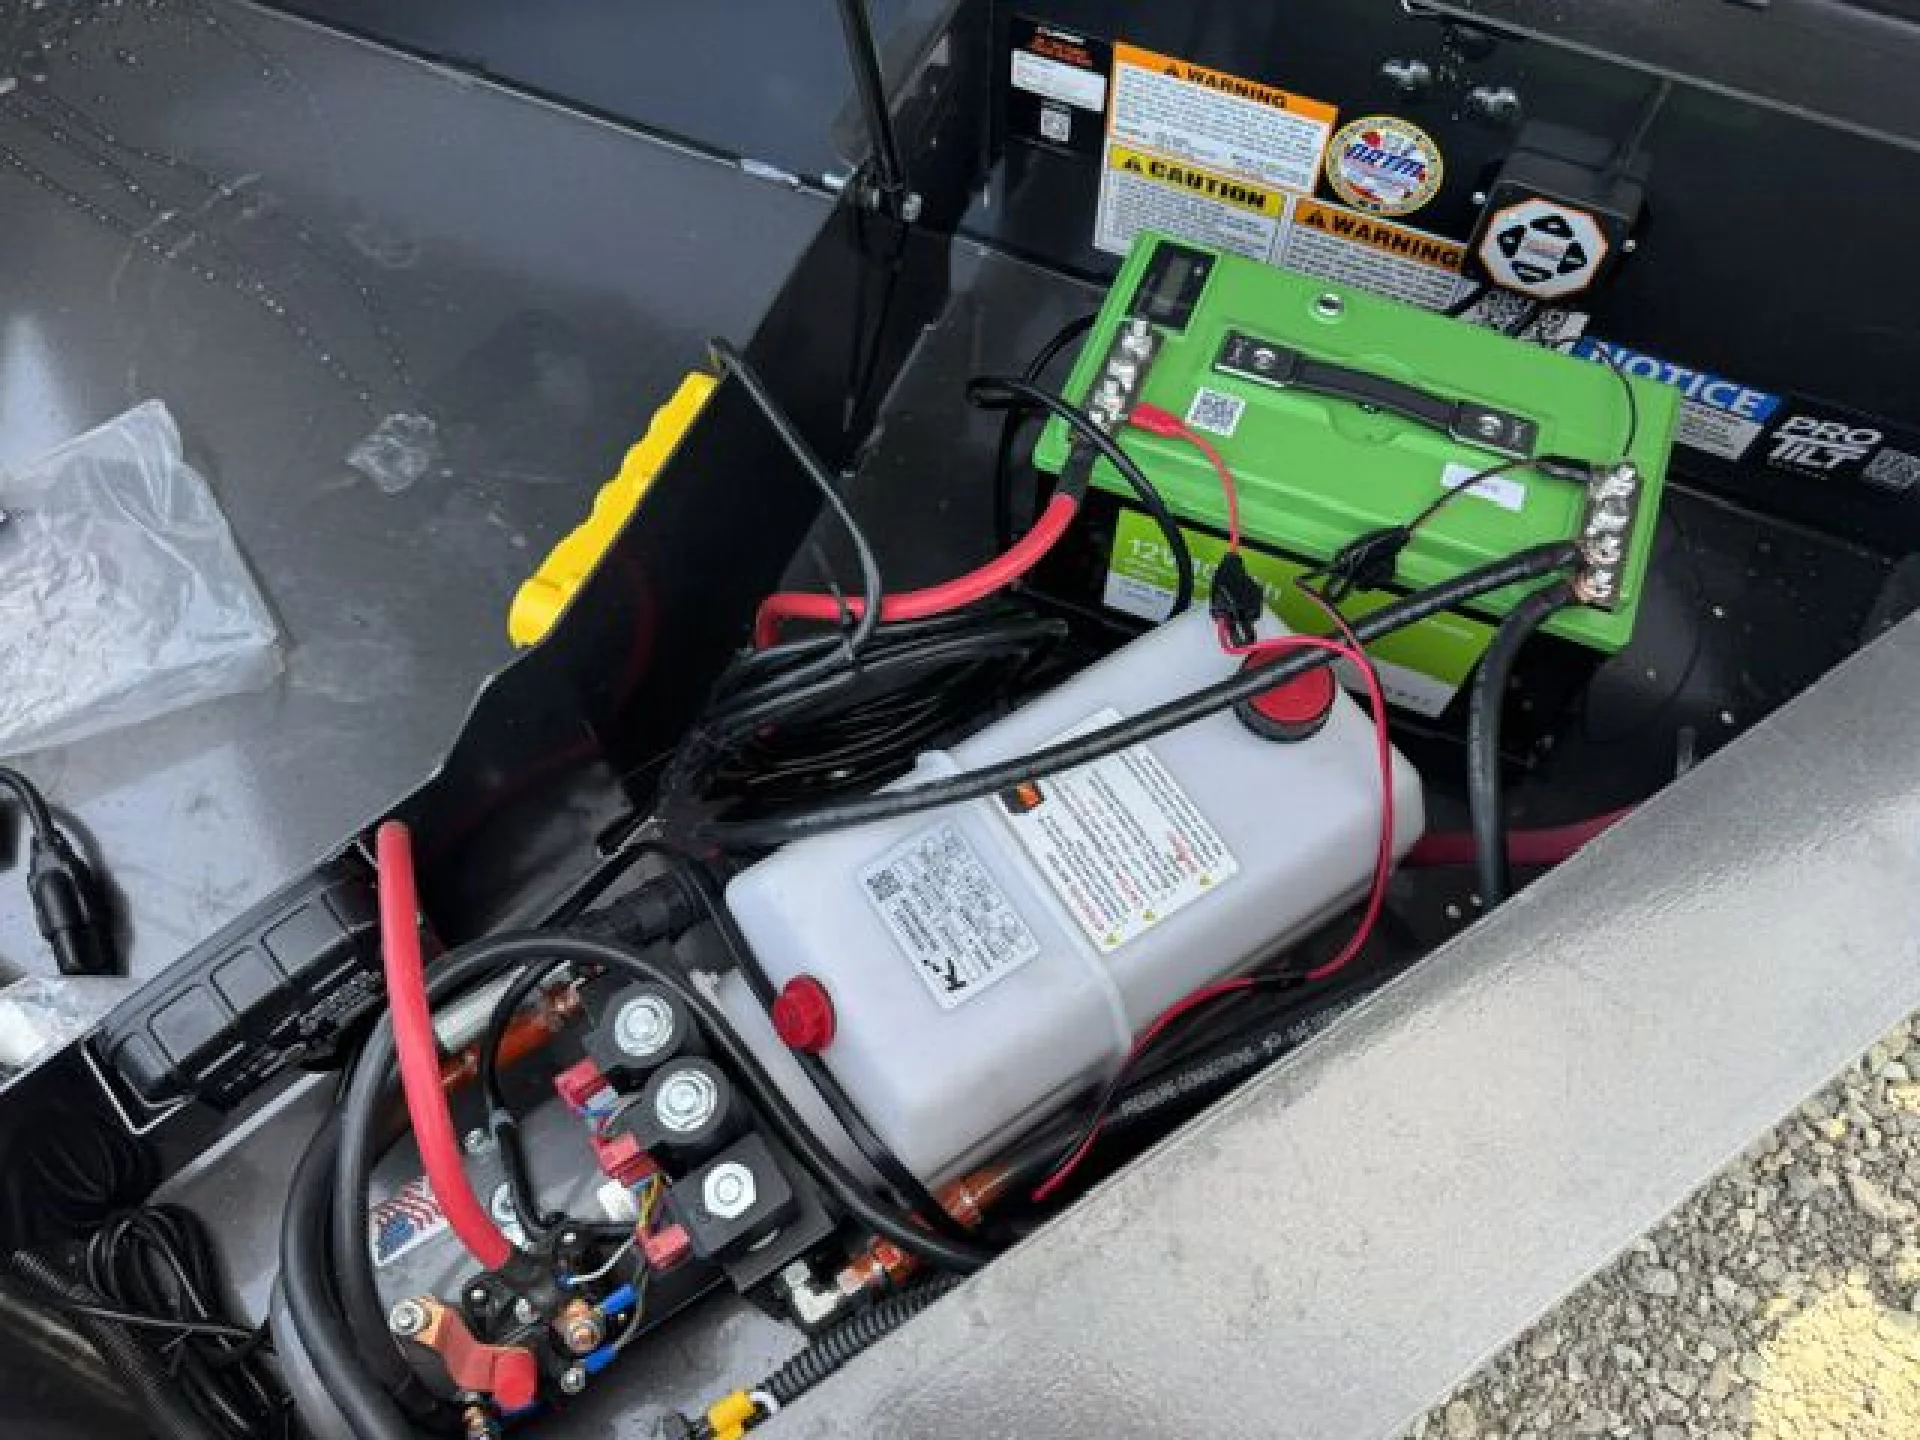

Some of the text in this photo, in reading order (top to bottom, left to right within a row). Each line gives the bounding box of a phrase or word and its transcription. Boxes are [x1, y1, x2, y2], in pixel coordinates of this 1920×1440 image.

[1187, 67, 1288, 109] WARNING
[1149, 160, 1267, 209] CAUTION
[1334, 215, 1460, 270] WARNING
[1590, 341, 1766, 419] NOTICE
[1767, 431, 1868, 469] TILT
[1780, 416, 1883, 445] PRO
